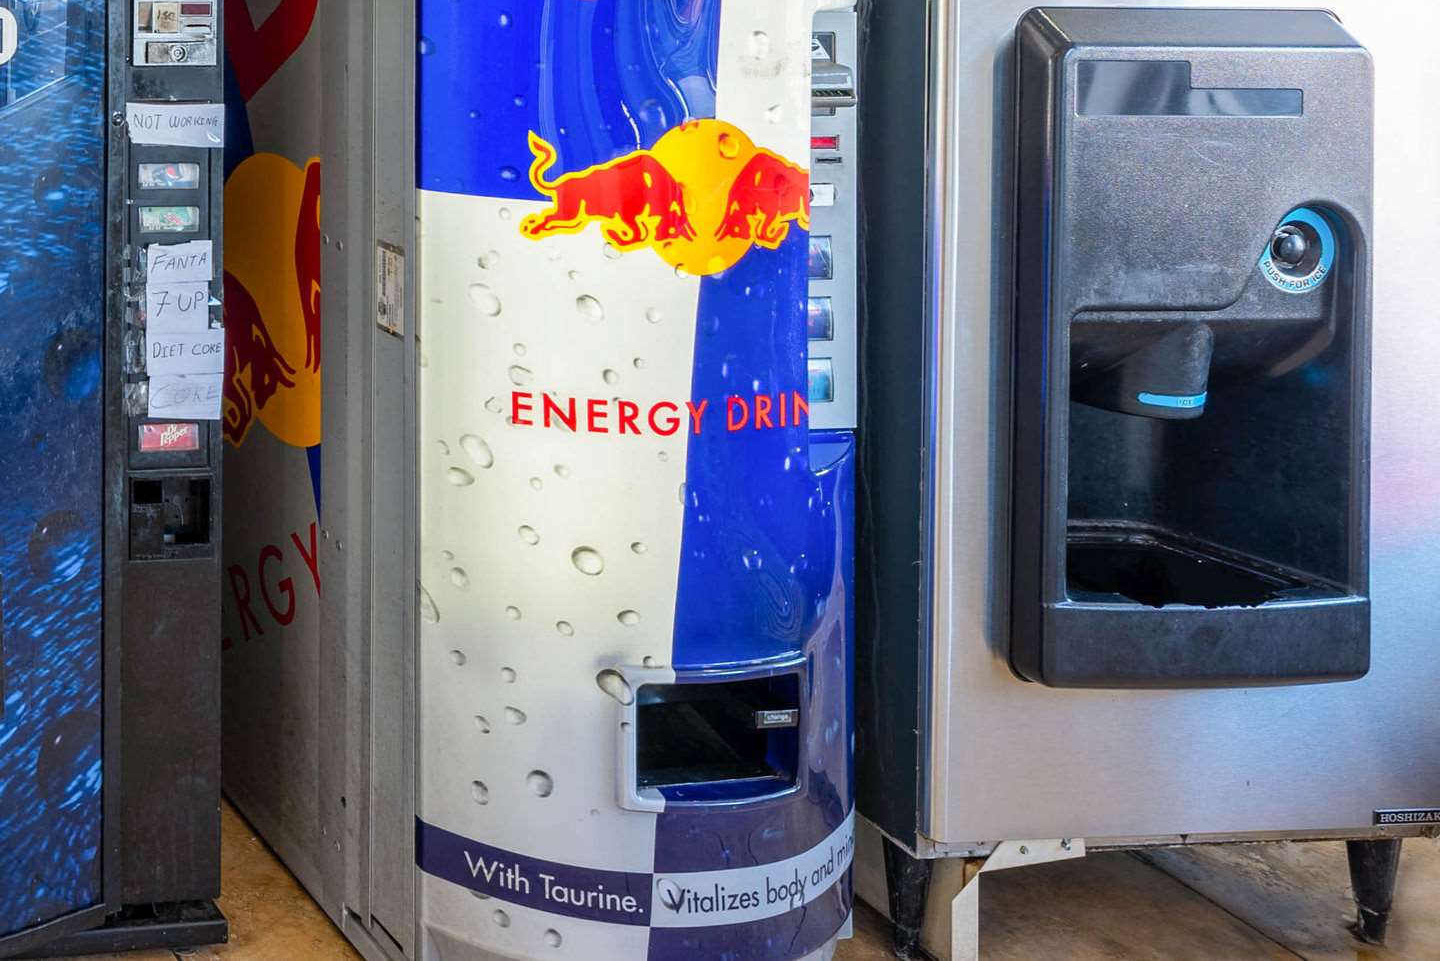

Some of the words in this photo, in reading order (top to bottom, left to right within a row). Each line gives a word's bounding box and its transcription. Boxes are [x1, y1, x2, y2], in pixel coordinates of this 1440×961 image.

[134, 113, 162, 130] NOT
[169, 115, 219, 129] WORKING
[151, 252, 207, 273] FANTA
[1263, 260, 1286, 286] PUSH
[1289, 280, 1311, 289] FOR
[1312, 265, 1327, 283] ICE
[152, 290, 171, 317] 7
[177, 291, 205, 312] UP
[152, 342, 184, 359] DIET
[191, 341, 222, 356] COKE
[512, 391, 708, 436] ENERGY
[464, 850, 530, 894] With
[539, 874, 644, 914] Taurine.
[667, 882, 760, 914] Vitalizes
[766, 868, 807, 904] body
[811, 846, 834, 886] and
